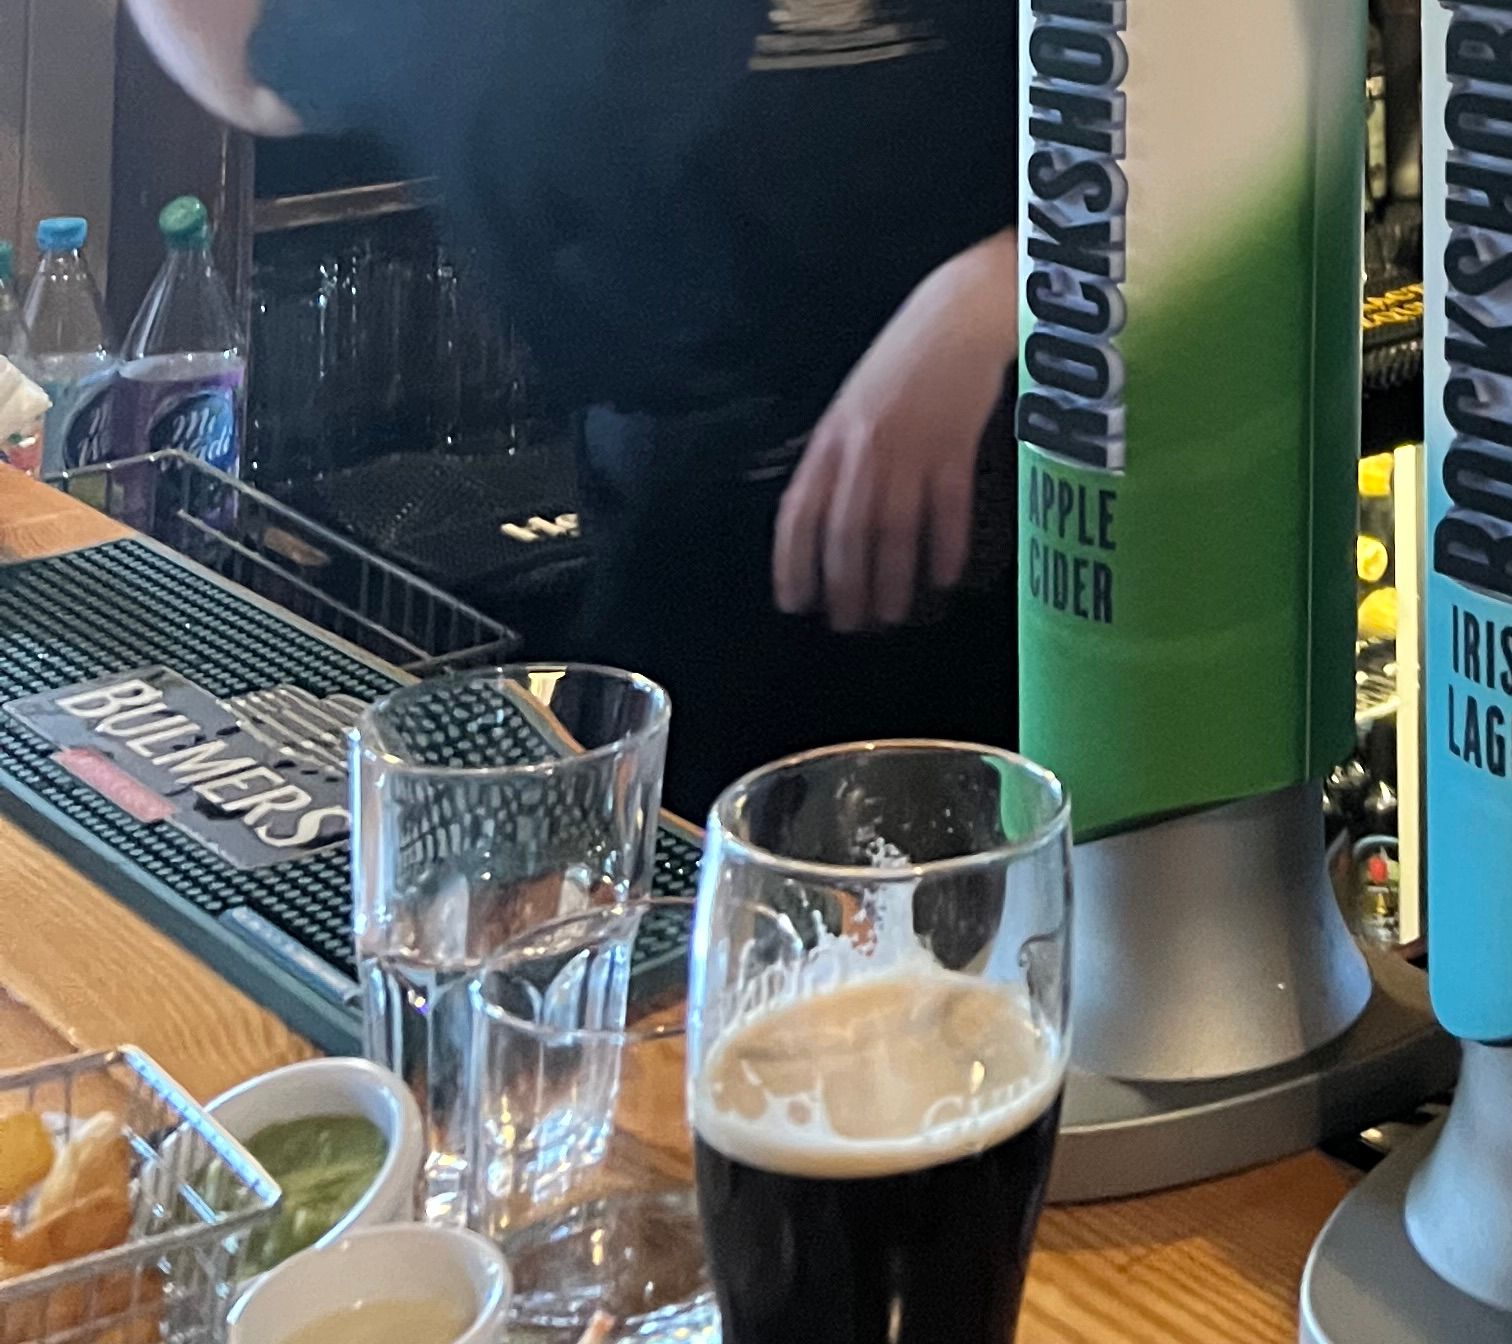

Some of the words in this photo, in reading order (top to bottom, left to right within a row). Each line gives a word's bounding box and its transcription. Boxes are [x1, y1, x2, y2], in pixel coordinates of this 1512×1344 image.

[1027, 463, 1117, 552] APPLE
[1028, 545, 1115, 626] CIDER
[56, 677, 351, 849] BULMERS
